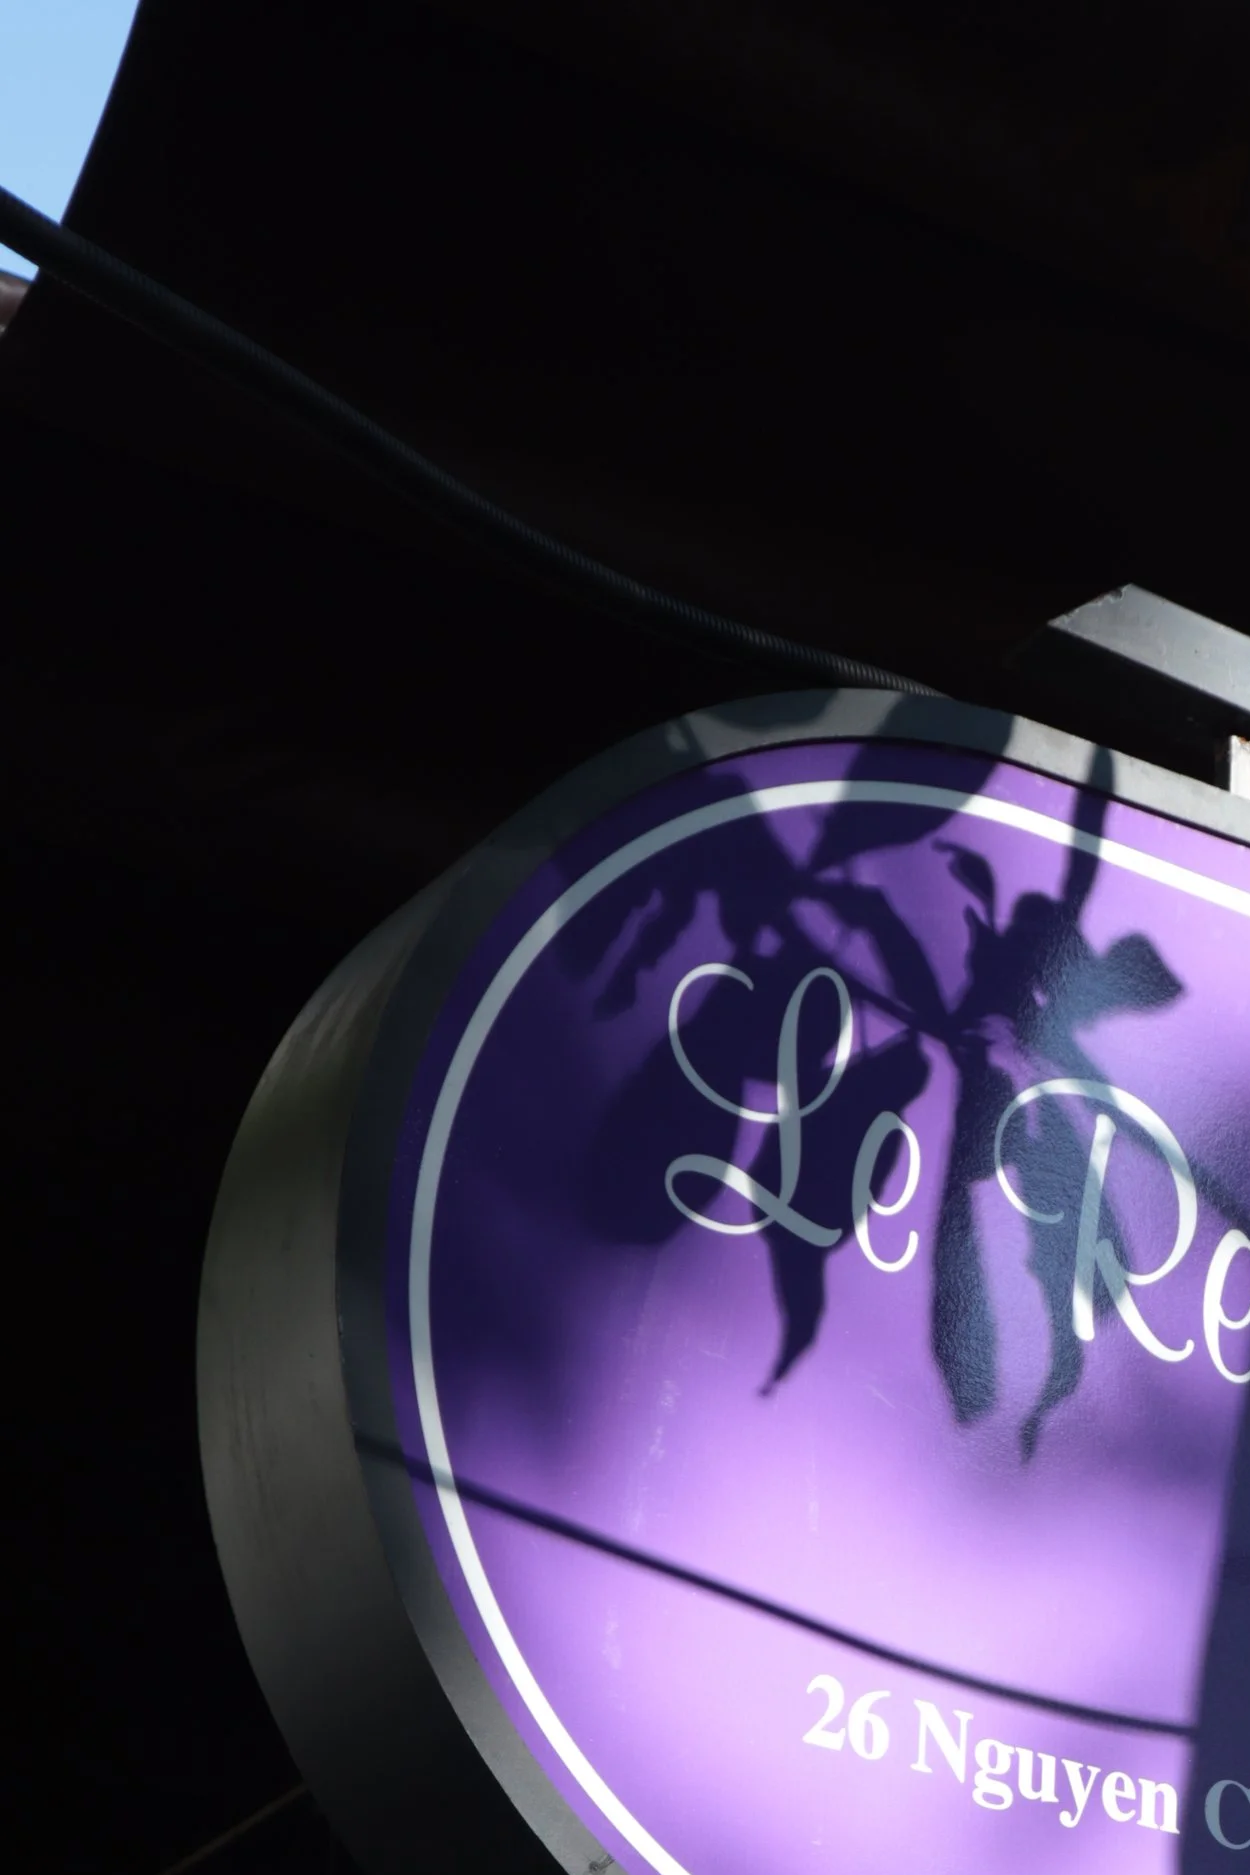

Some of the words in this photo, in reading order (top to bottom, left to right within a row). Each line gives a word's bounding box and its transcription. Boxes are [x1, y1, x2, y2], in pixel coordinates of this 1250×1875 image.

[665, 963, 920, 1272] Le
[802, 1674, 891, 1760] 26
[910, 1699, 1180, 1834] Nguyen
